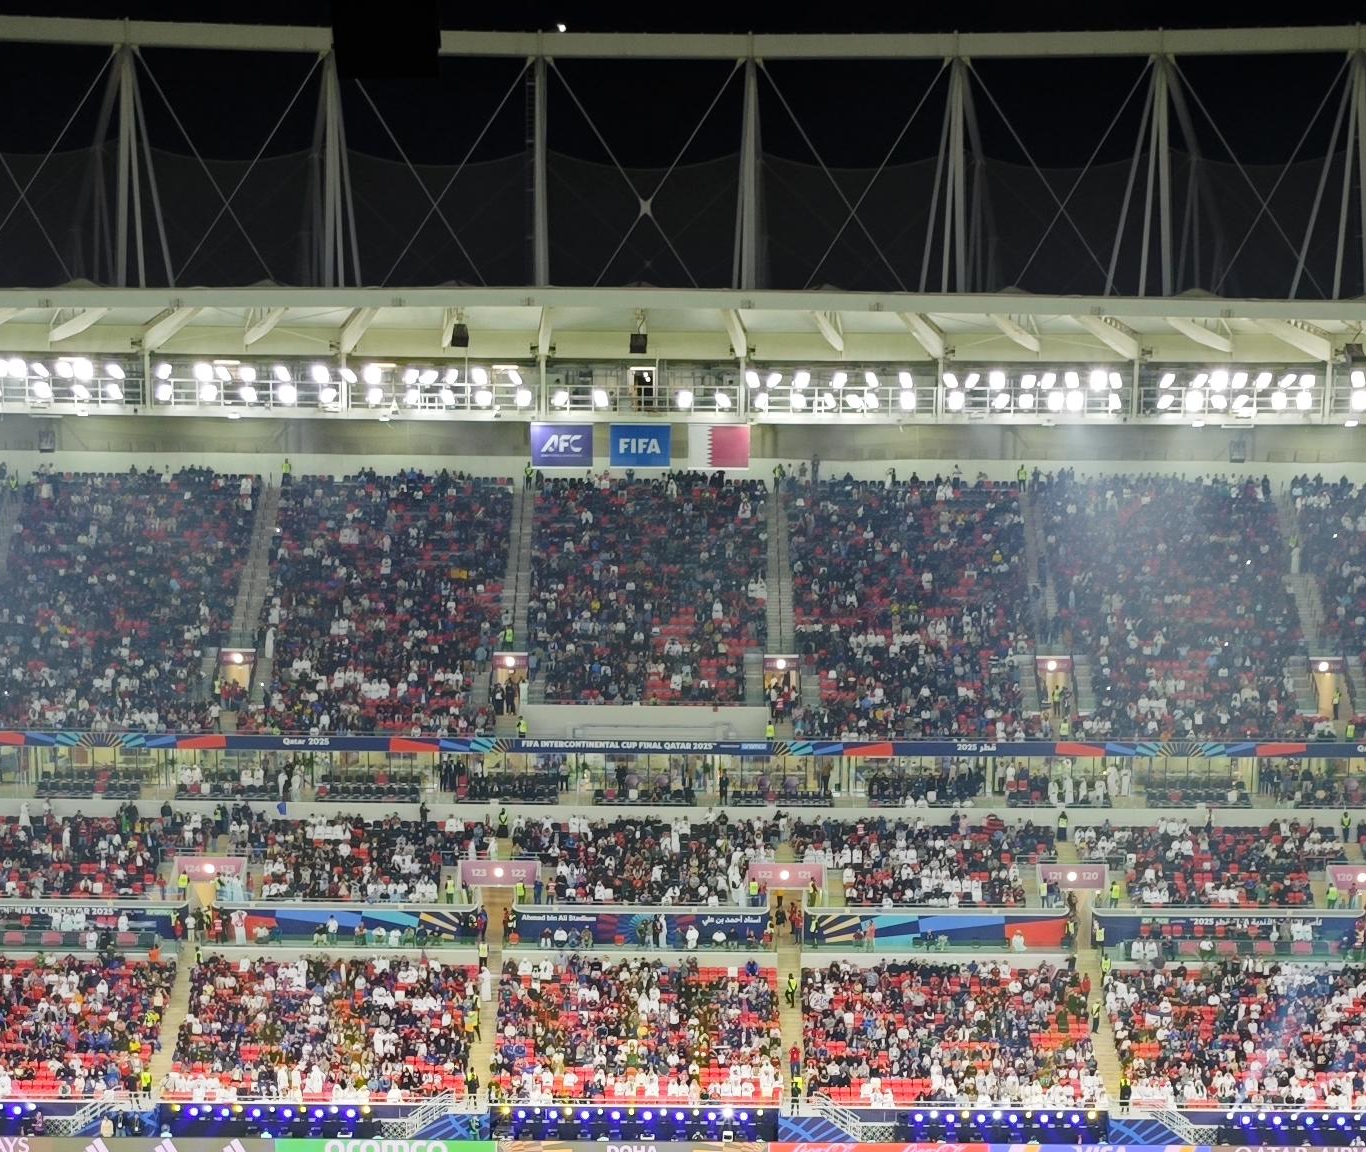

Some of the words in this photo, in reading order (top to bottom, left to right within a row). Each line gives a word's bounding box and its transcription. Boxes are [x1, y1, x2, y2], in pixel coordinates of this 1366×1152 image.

[541, 434, 582, 453] AFC
[619, 438, 661, 454] FIFA
[282, 737, 306, 746] Qatar
[307, 737, 330, 746] 2025
[521, 740, 540, 749] FIFA
[540, 741, 620, 749] INTERCONTINENTAL
[621, 741, 638, 750] CUP
[639, 741, 663, 750] FINAL
[664, 741, 692, 750] QATAR
[956, 743, 977, 752] 2025
[471, 869, 487, 878] 123
[511, 869, 527, 878] 122
[1048, 871, 1063, 880] 121
[1082, 871, 1099, 880] 120
[1336, 873, 1353, 882] 120
[1193, 918, 1215, 926] 2025
